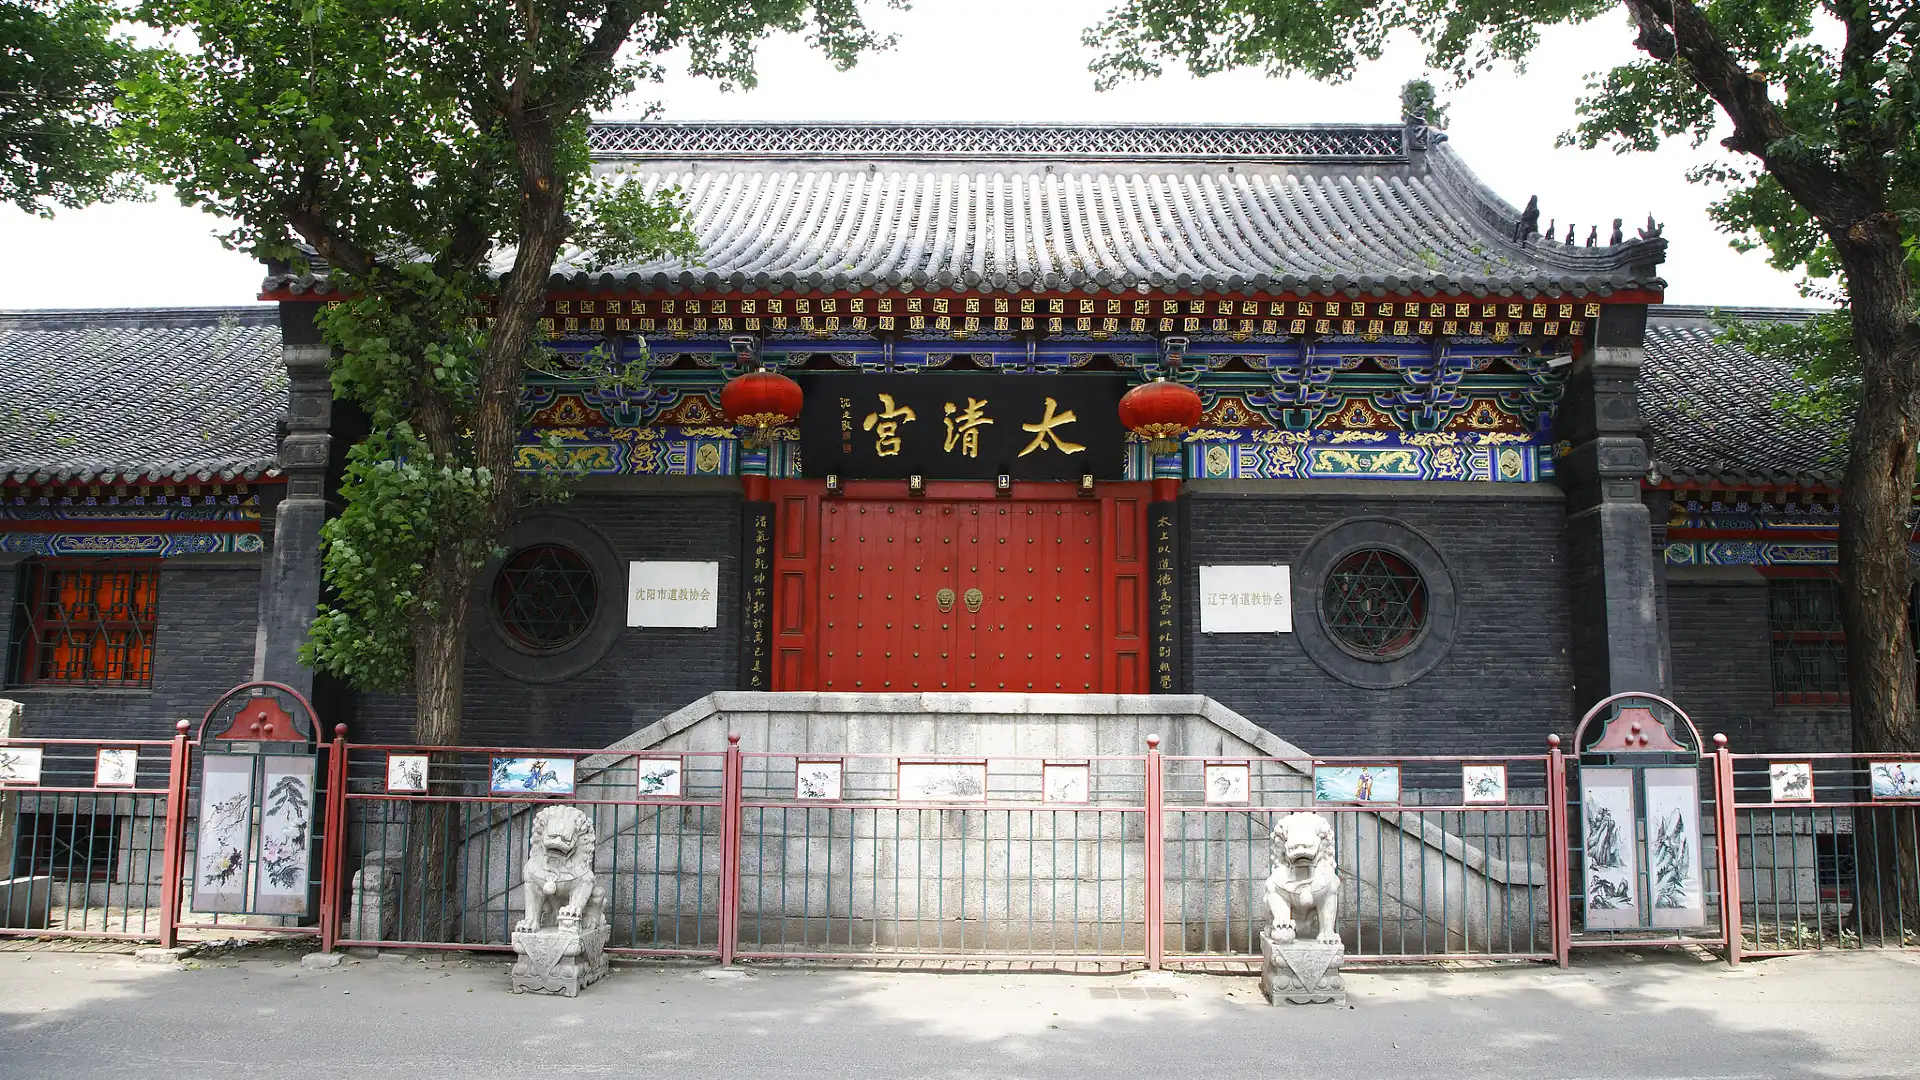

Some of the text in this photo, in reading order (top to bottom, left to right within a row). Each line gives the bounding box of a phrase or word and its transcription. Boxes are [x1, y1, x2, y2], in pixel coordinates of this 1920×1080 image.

[635, 587, 711, 601] 沈阳市道教协会
[1207, 591, 1284, 606] 辽宁省道教协会
